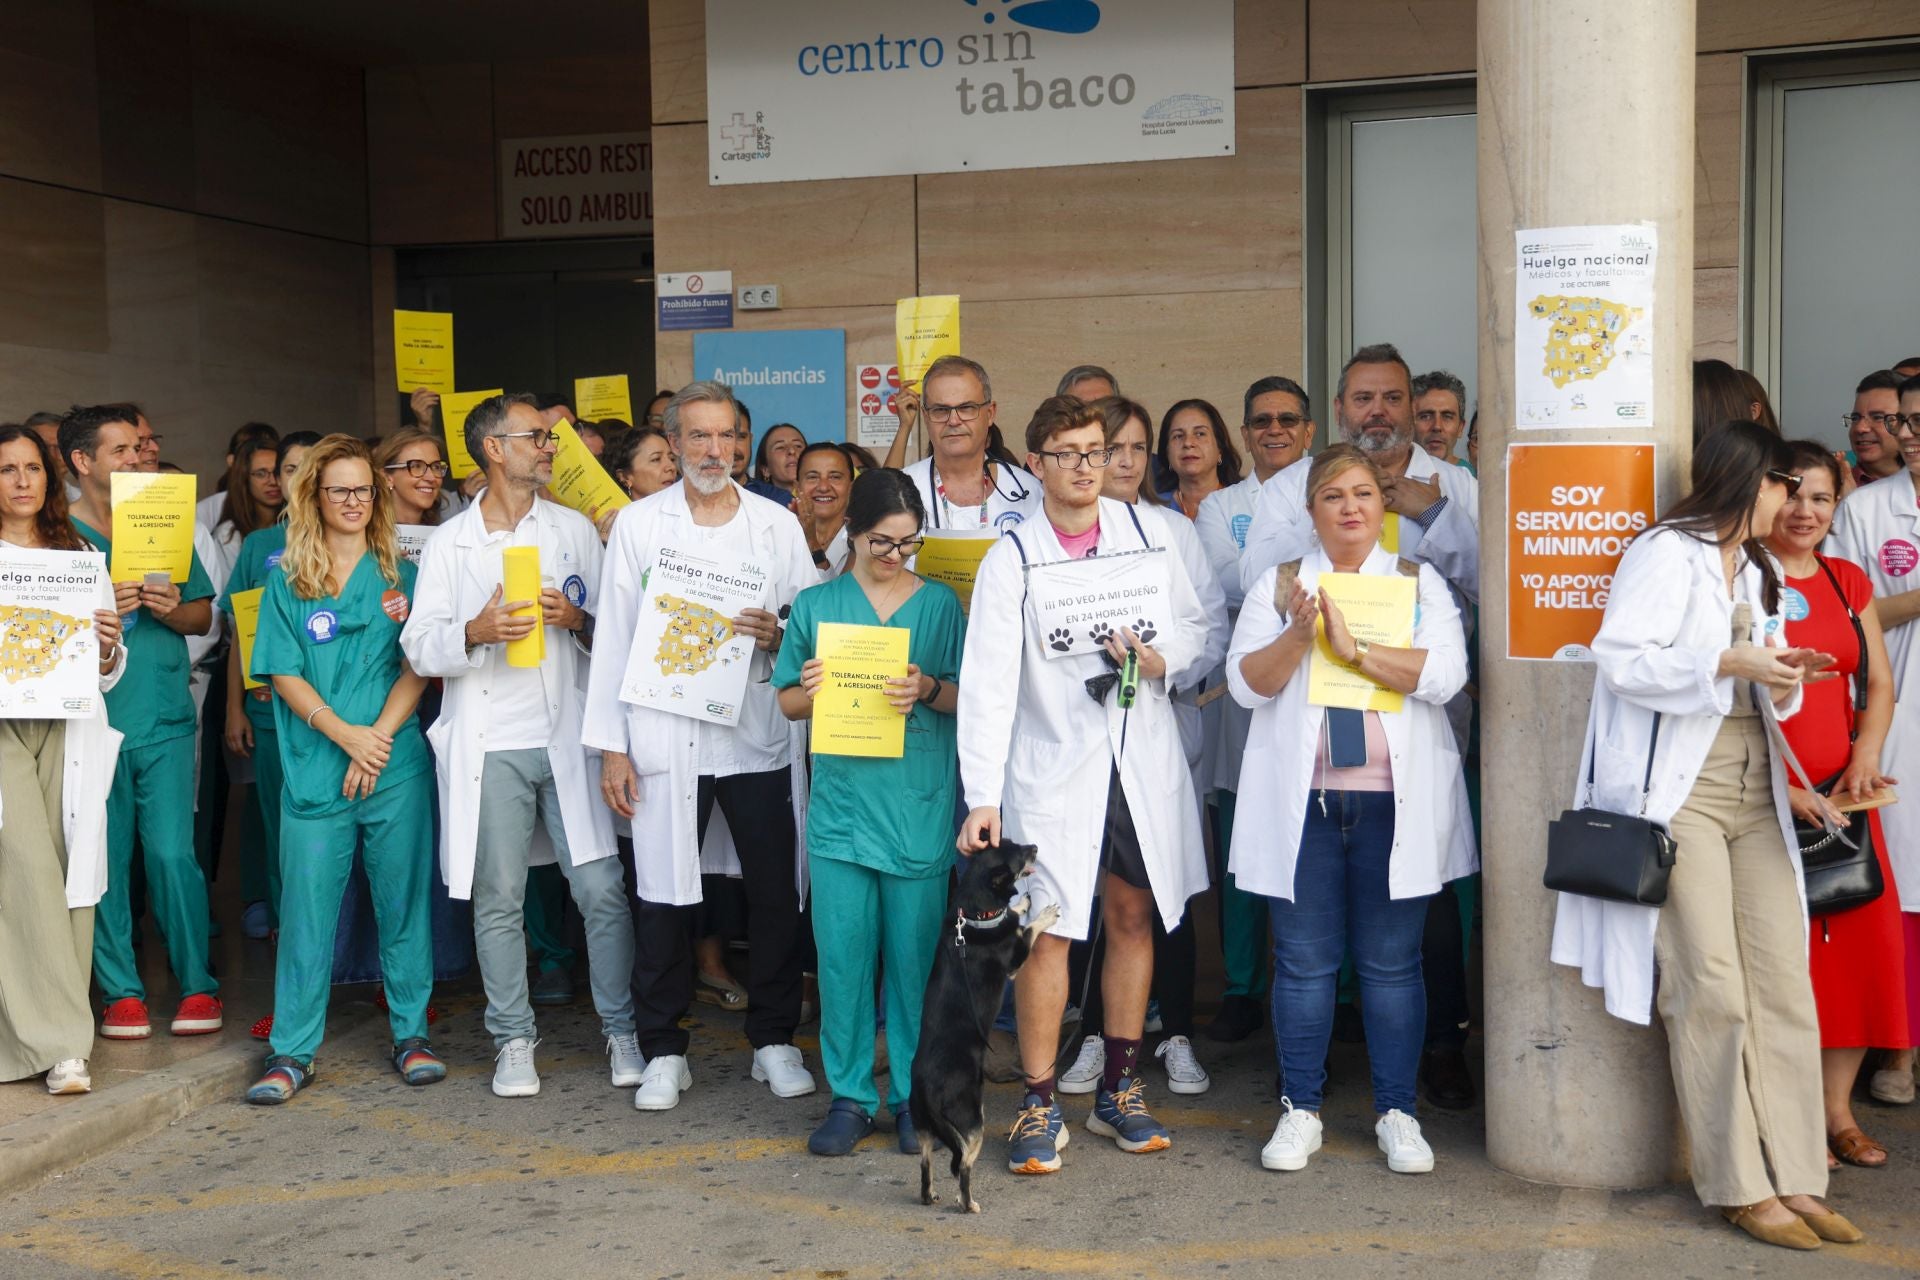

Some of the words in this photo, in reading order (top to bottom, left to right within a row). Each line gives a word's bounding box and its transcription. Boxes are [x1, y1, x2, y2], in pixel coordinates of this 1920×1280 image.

[798, 34, 944, 76] centro
[957, 29, 1036, 66] sin
[955, 67, 1136, 115] tabaco
[1142, 121, 1164, 129] Hospital
[514, 146, 592, 177] ACCESO
[601, 143, 653, 173] REST
[521, 195, 571, 225] SOLO
[579, 192, 653, 223] AMBUL
[1523, 256, 1576, 269] Huelga
[1584, 253, 1649, 265] nacional
[1529, 269, 1572, 279] Médicos
[1575, 270, 1581, 278] y
[1585, 267, 1646, 277] facultativos
[662, 299, 702, 308] Prohibido
[703, 299, 728, 307] fumar
[713, 366, 826, 385] Ambulancias
[1551, 486, 1605, 506] SOY
[1515, 511, 1647, 531] SERVICIOS
[38, 574, 97, 584] nacional
[658, 558, 703, 578] Huelga
[707, 570, 763, 592] nacional
[1520, 574, 1544, 589] YO
[1547, 574, 1613, 589] APOYO
[0, 584, 27, 592] dicos
[39, 585, 93, 593] facultativos
[661, 571, 696, 586] Médicos
[706, 582, 757, 601] facultativos
[697, 591, 724, 601] OCTUBRE
[1058, 598, 1074, 607] NO
[1075, 595, 1096, 605] VEO
[1107, 591, 1121, 600] MI
[1123, 585, 1158, 598] DUEÑO
[1535, 591, 1610, 609] HUELG
[1066, 615, 1079, 624] EN
[1080, 613, 1093, 622] 24
[1095, 607, 1128, 619] HORAS
[1131, 605, 1142, 615] !!!
[831, 672, 871, 680] TOLERANCIA
[844, 682, 883, 690] AGRESIONES
